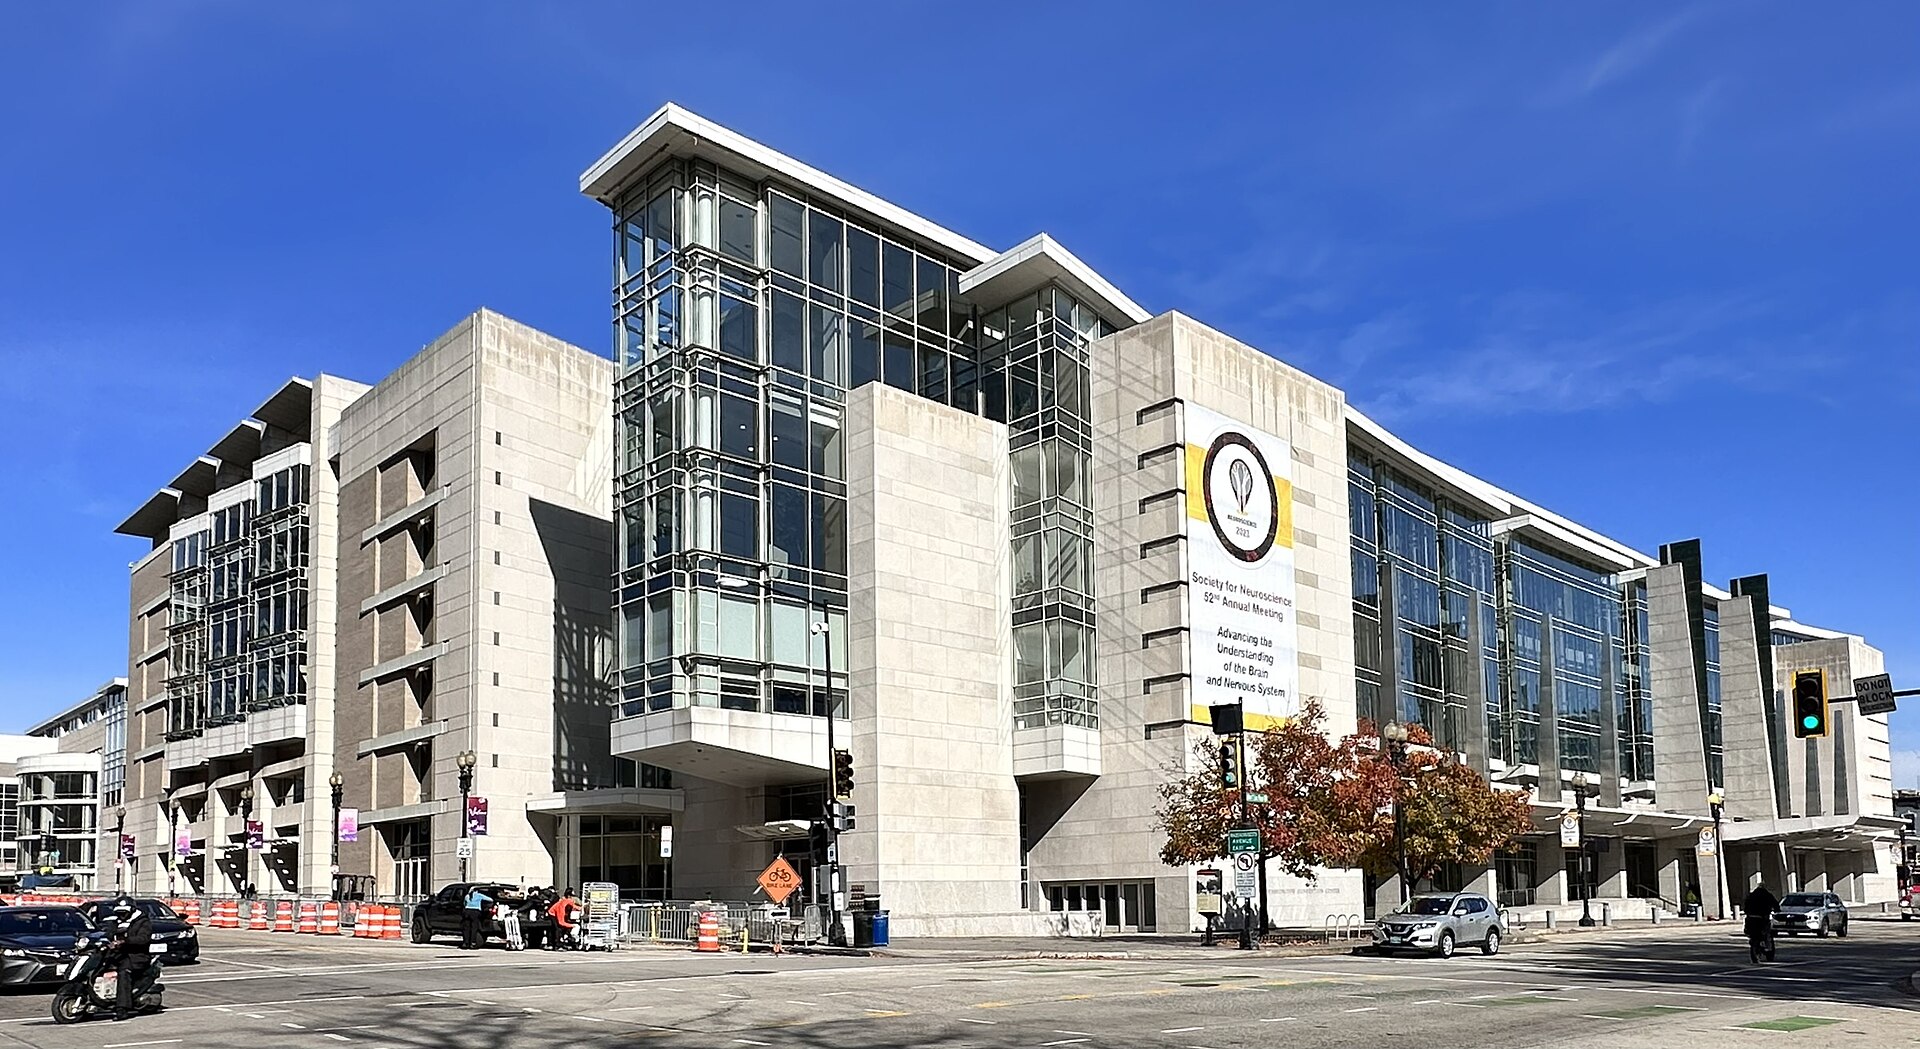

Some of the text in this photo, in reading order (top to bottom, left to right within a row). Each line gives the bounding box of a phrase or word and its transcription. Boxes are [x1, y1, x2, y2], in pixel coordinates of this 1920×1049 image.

[1192, 571, 1292, 608] Society for Neuroscience
[1222, 596, 1251, 613] Annual
[1252, 602, 1284, 623] Meeting
[1217, 626, 1273, 648] Advancing the
[1217, 642, 1274, 667] Understanding
[1223, 661, 1269, 679] of the Brain
[1206, 676, 1286, 698] and Nervous System
[1856, 679, 1889, 692] DO NOT
[1859, 691, 1892, 703] BLOCK
[458, 847, 471, 856] 25
